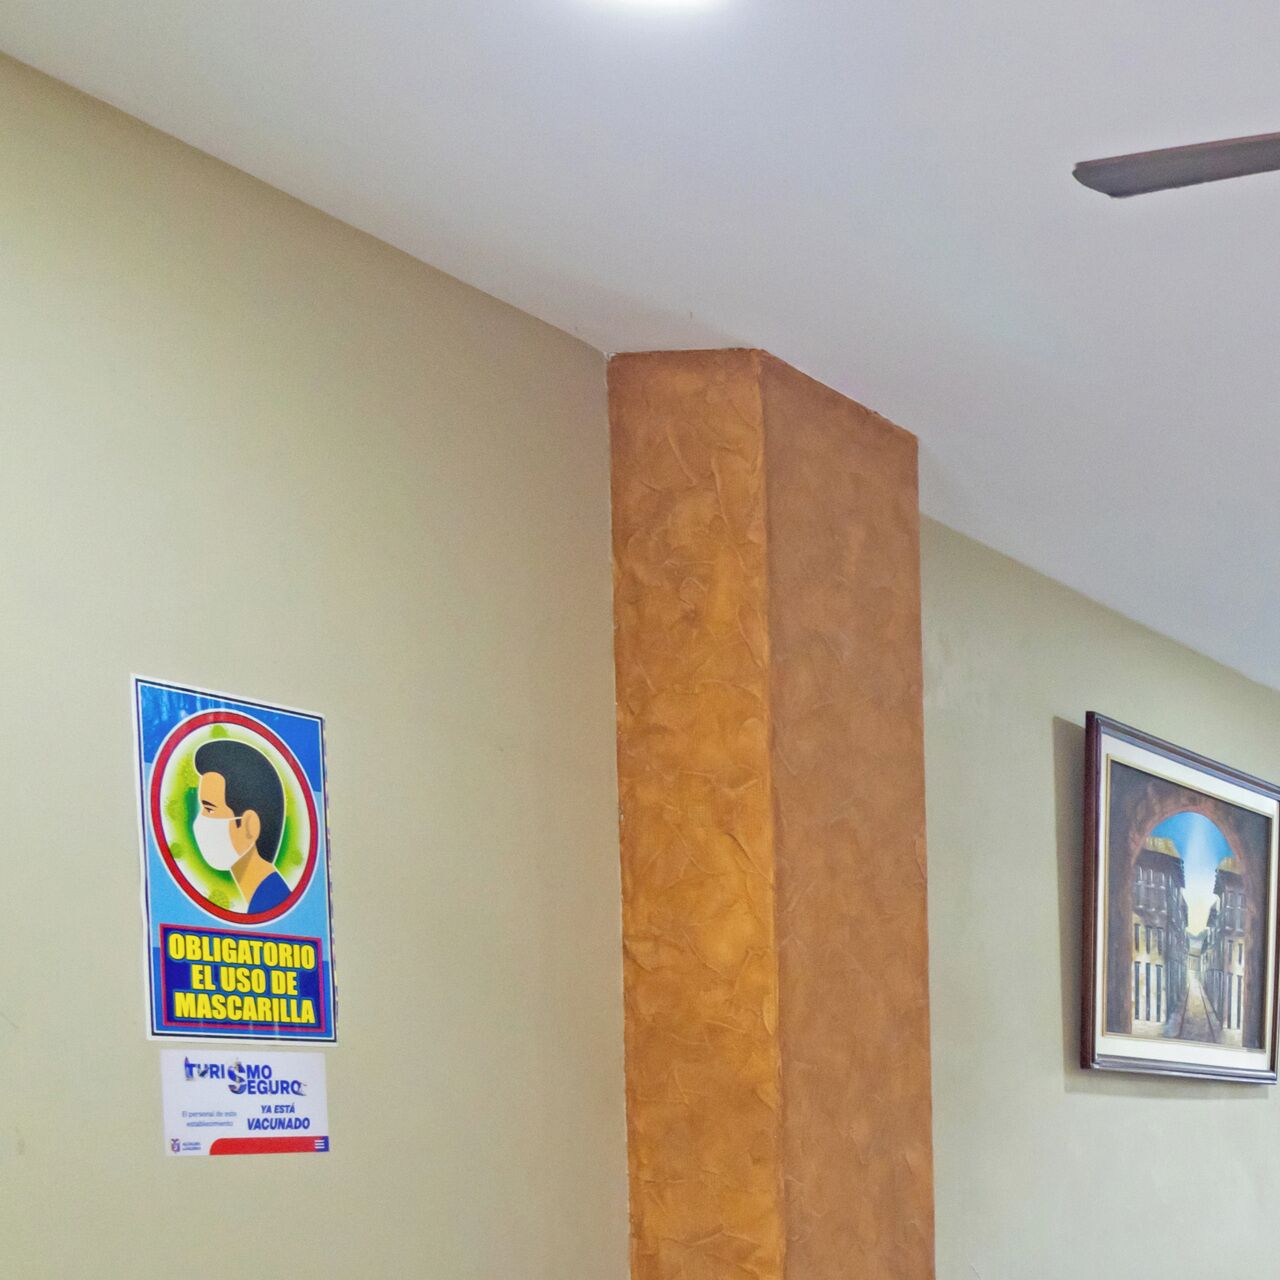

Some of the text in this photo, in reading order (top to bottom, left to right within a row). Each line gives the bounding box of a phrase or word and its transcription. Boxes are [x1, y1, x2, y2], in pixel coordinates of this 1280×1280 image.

[168, 933, 315, 970] OBLIGATORIO
[191, 964, 298, 996] EL USO DE
[174, 992, 316, 1024] MASCARILLA
[247, 1117, 311, 1130] VACUNADO
[261, 1102, 296, 1114] YA ESTÁ
